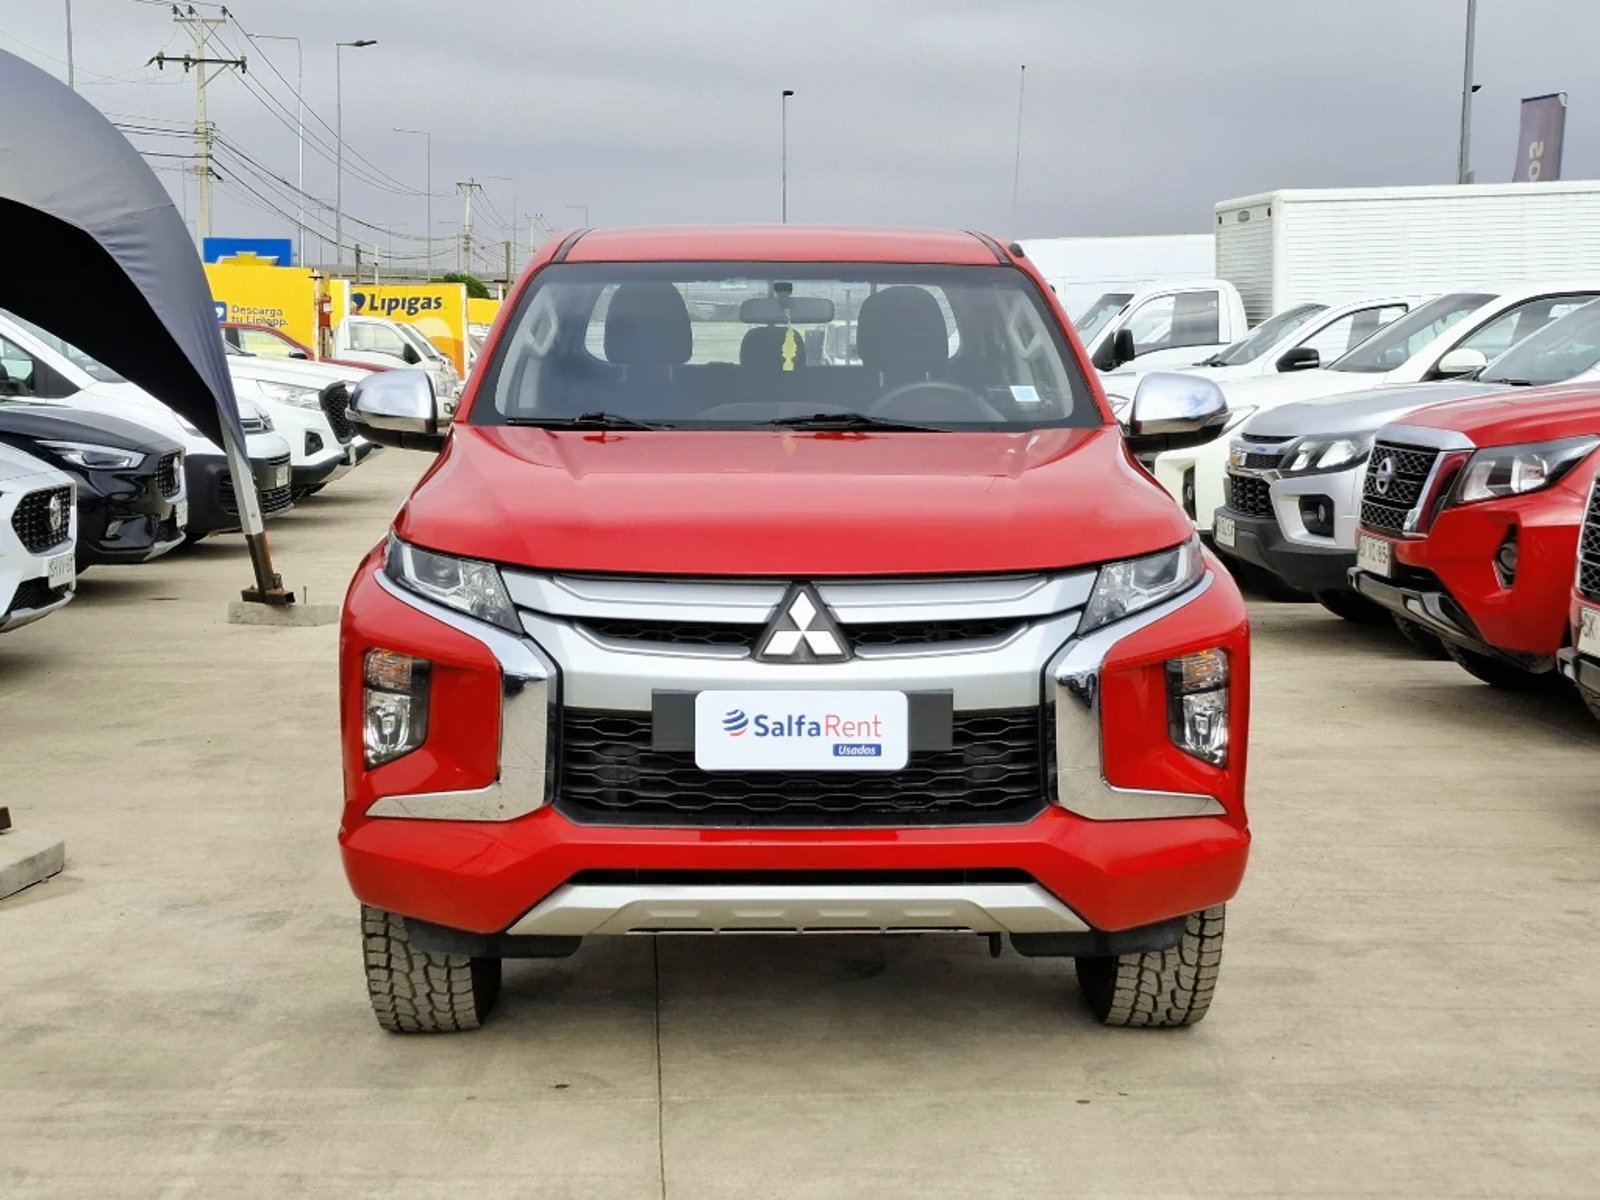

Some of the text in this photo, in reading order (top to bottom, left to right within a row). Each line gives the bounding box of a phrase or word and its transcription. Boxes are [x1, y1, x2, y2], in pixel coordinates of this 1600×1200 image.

[231, 304, 284, 318] Descarga
[369, 293, 443, 316] Lipigas
[838, 743, 877, 756] Usados
